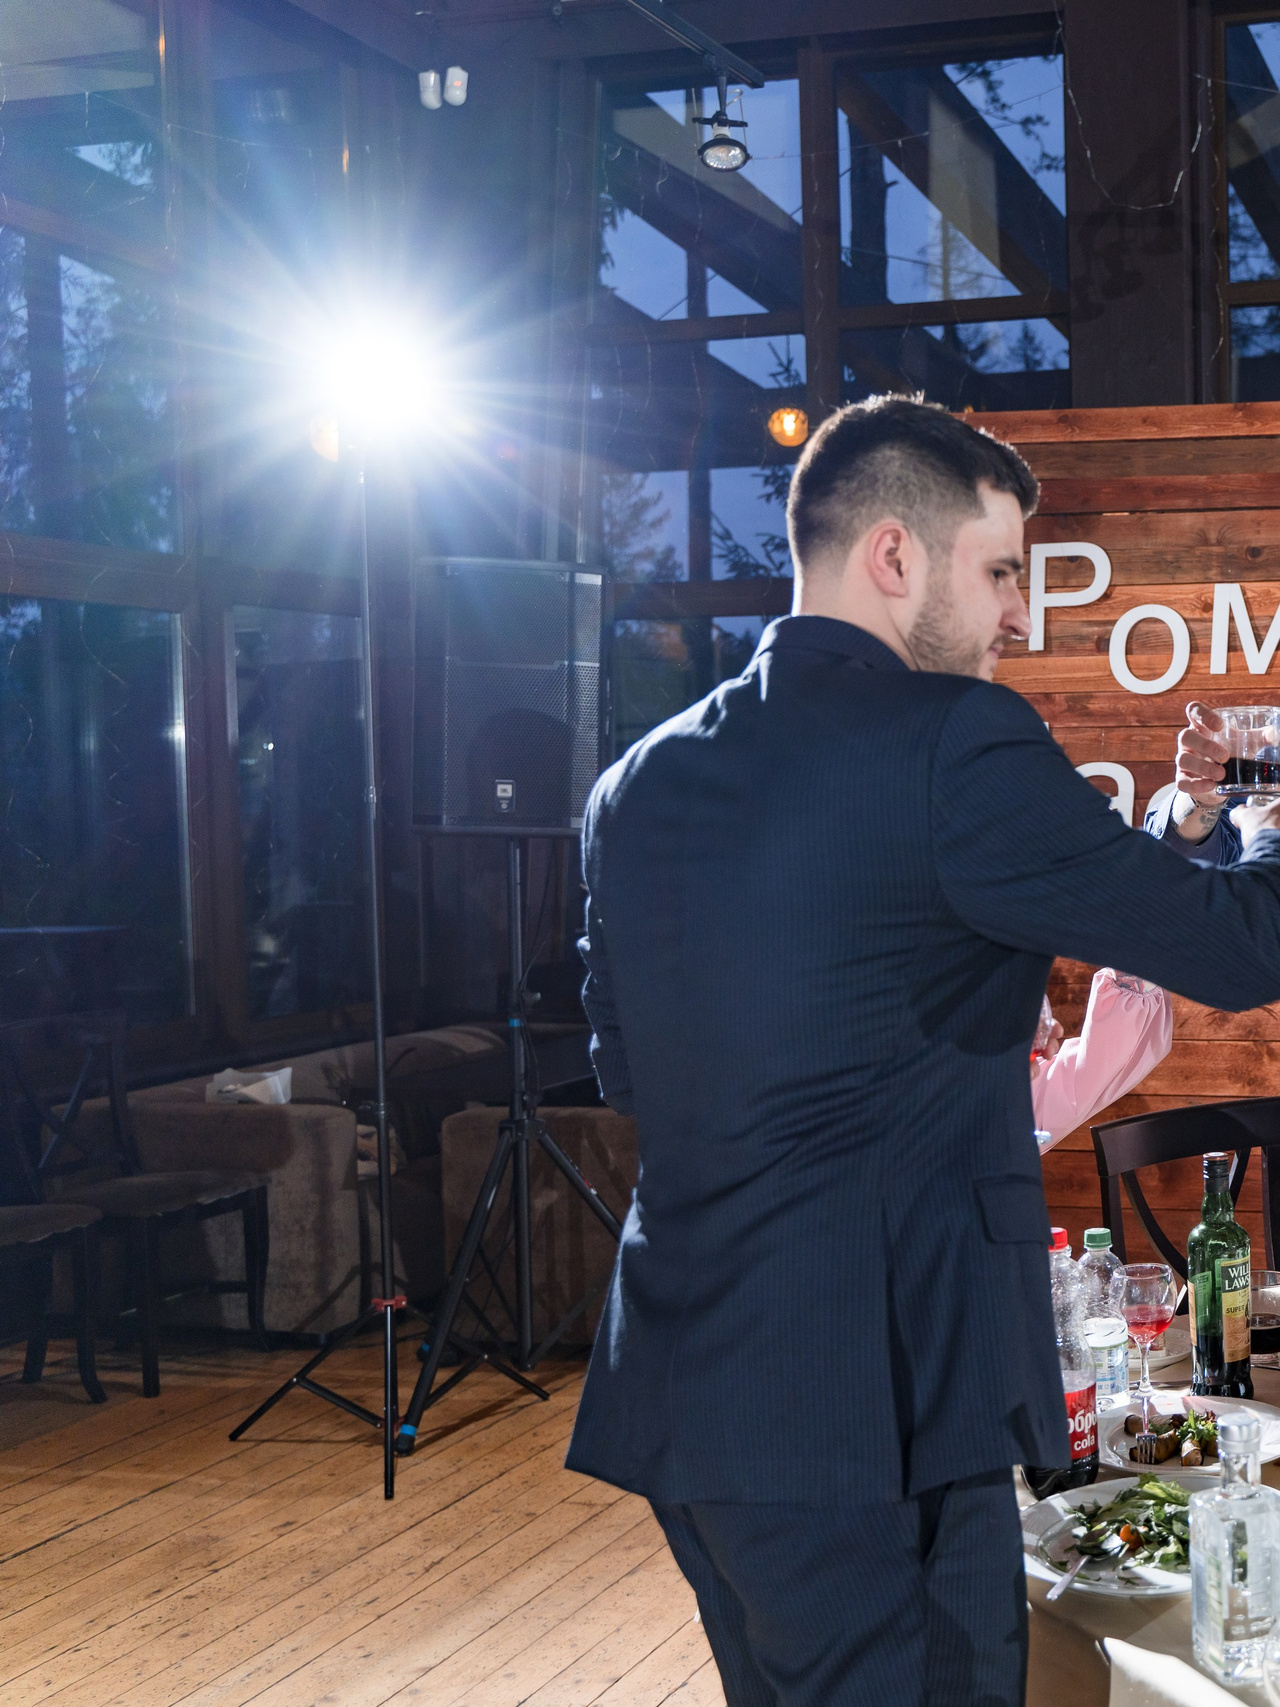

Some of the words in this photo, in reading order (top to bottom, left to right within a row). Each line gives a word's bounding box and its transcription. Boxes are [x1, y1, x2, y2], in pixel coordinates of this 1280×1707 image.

[1228, 1263, 1249, 1279] WILL
[1225, 1275, 1249, 1290] LAWS
[1226, 1304, 1245, 1314] SUPER
[1073, 1434, 1095, 1451] cola
